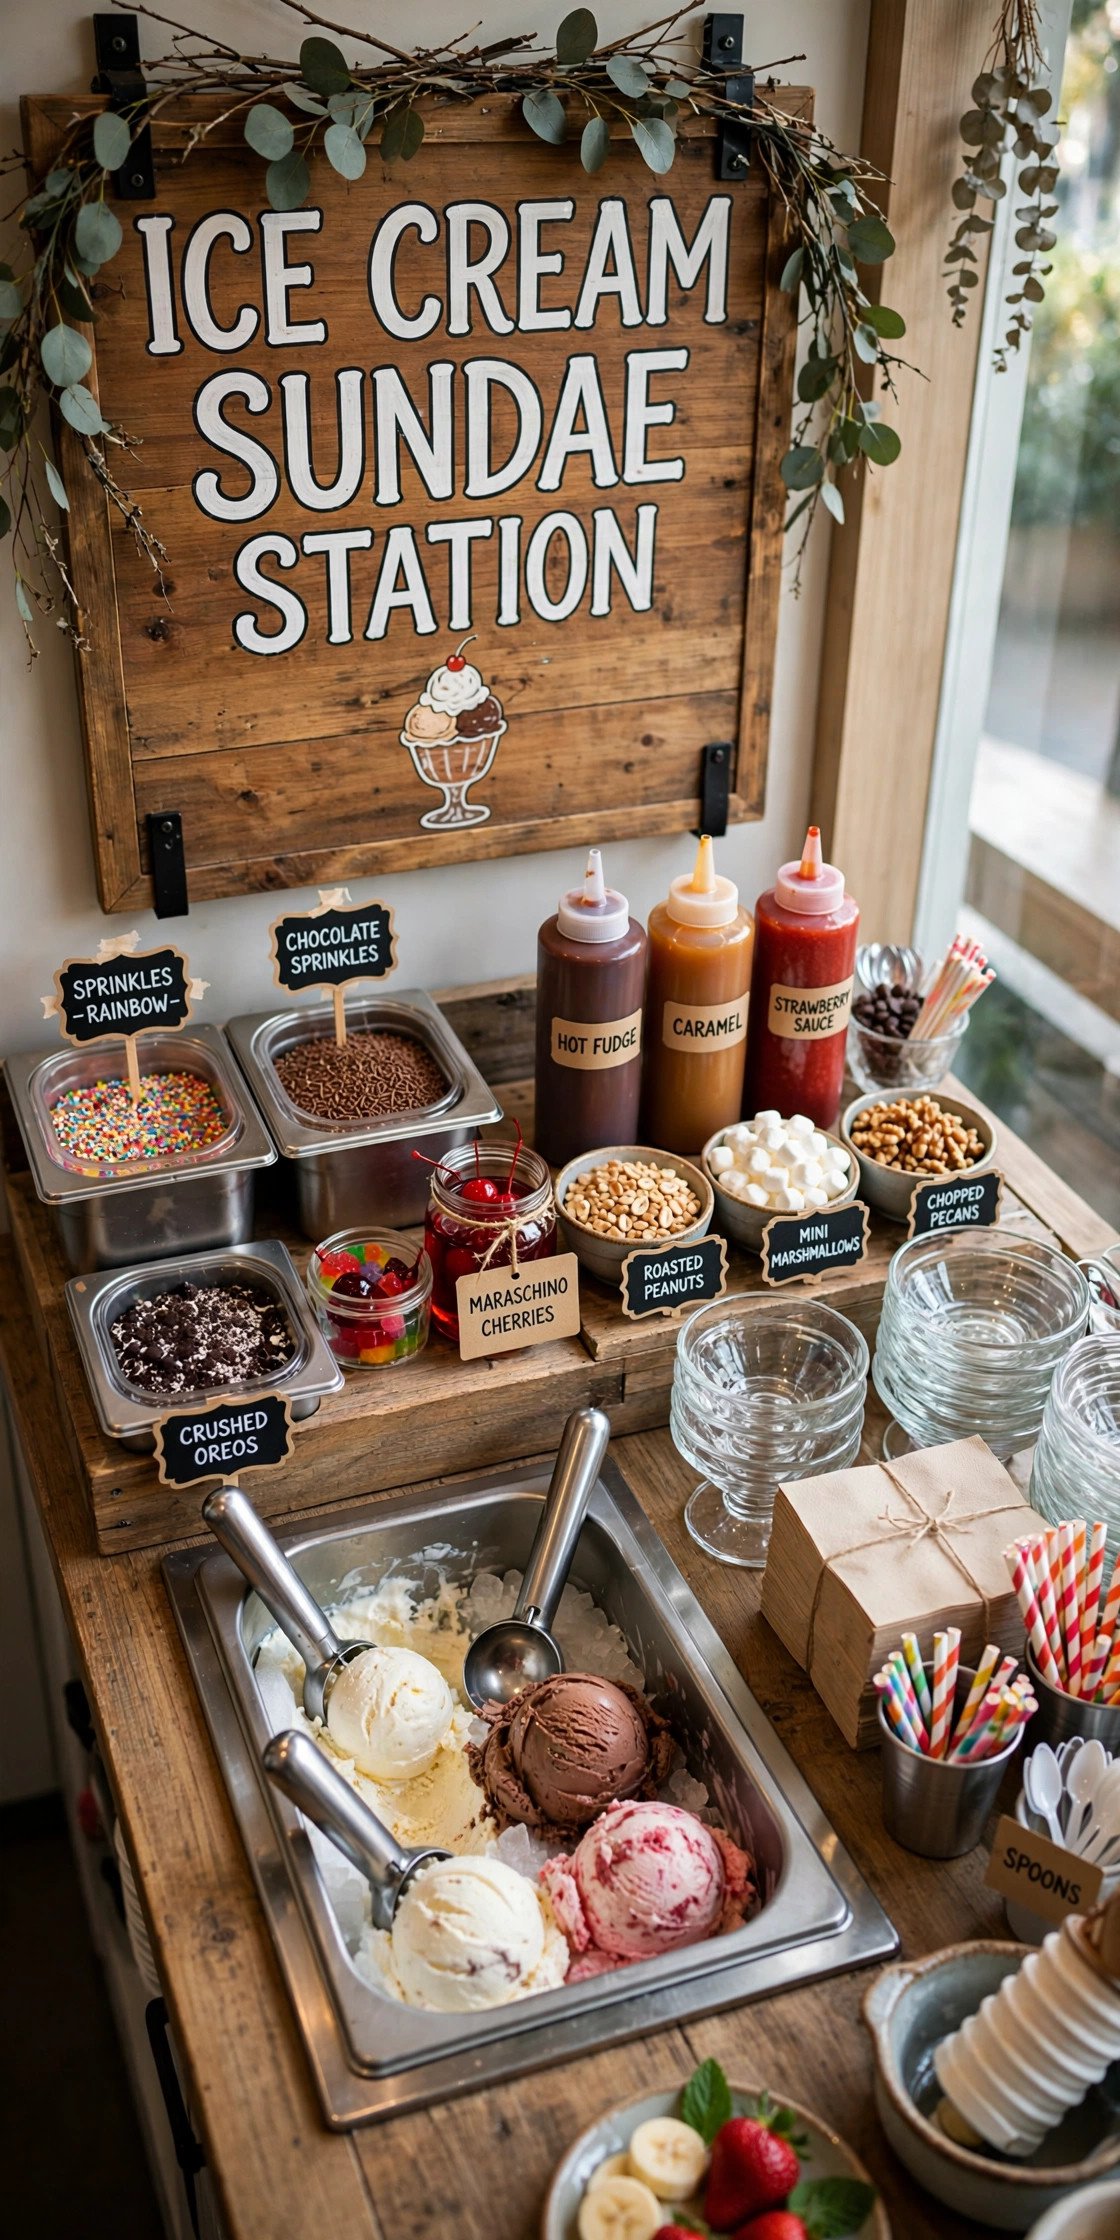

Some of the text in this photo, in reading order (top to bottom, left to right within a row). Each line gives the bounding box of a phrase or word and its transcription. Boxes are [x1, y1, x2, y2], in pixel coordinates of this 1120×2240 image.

[135, 195, 733, 356] ICE CREAM
[192, 347, 690, 523] SUNDAE
[232, 504, 658, 656] STATION
[285, 920, 381, 952] CHOCOLATE
[290, 944, 380, 974] SPRINKLES
[72, 966, 174, 1002] SPRINKLES
[774, 990, 851, 1015] STRAWBERRY
[672, 1012, 743, 1037] CARAMEL
[793, 1014, 835, 1033] SAUCE
[557, 1027, 638, 1055] HOT FUDGE
[926, 1184, 985, 1209] CHOPPED
[929, 1204, 980, 1226] PECANS
[798, 1223, 830, 1243] MINI
[770, 1235, 861, 1265] MARSHMALLOWS
[642, 1254, 704, 1279] ROASTED
[469, 1276, 569, 1315] MARASCHINO
[643, 1274, 705, 1299] PEANUTS
[481, 1304, 556, 1337] CHERRIES
[179, 1411, 268, 1446] CRUSHED
[193, 1436, 259, 1465] OREOS
[1003, 1846, 1082, 1905] SPOONS
